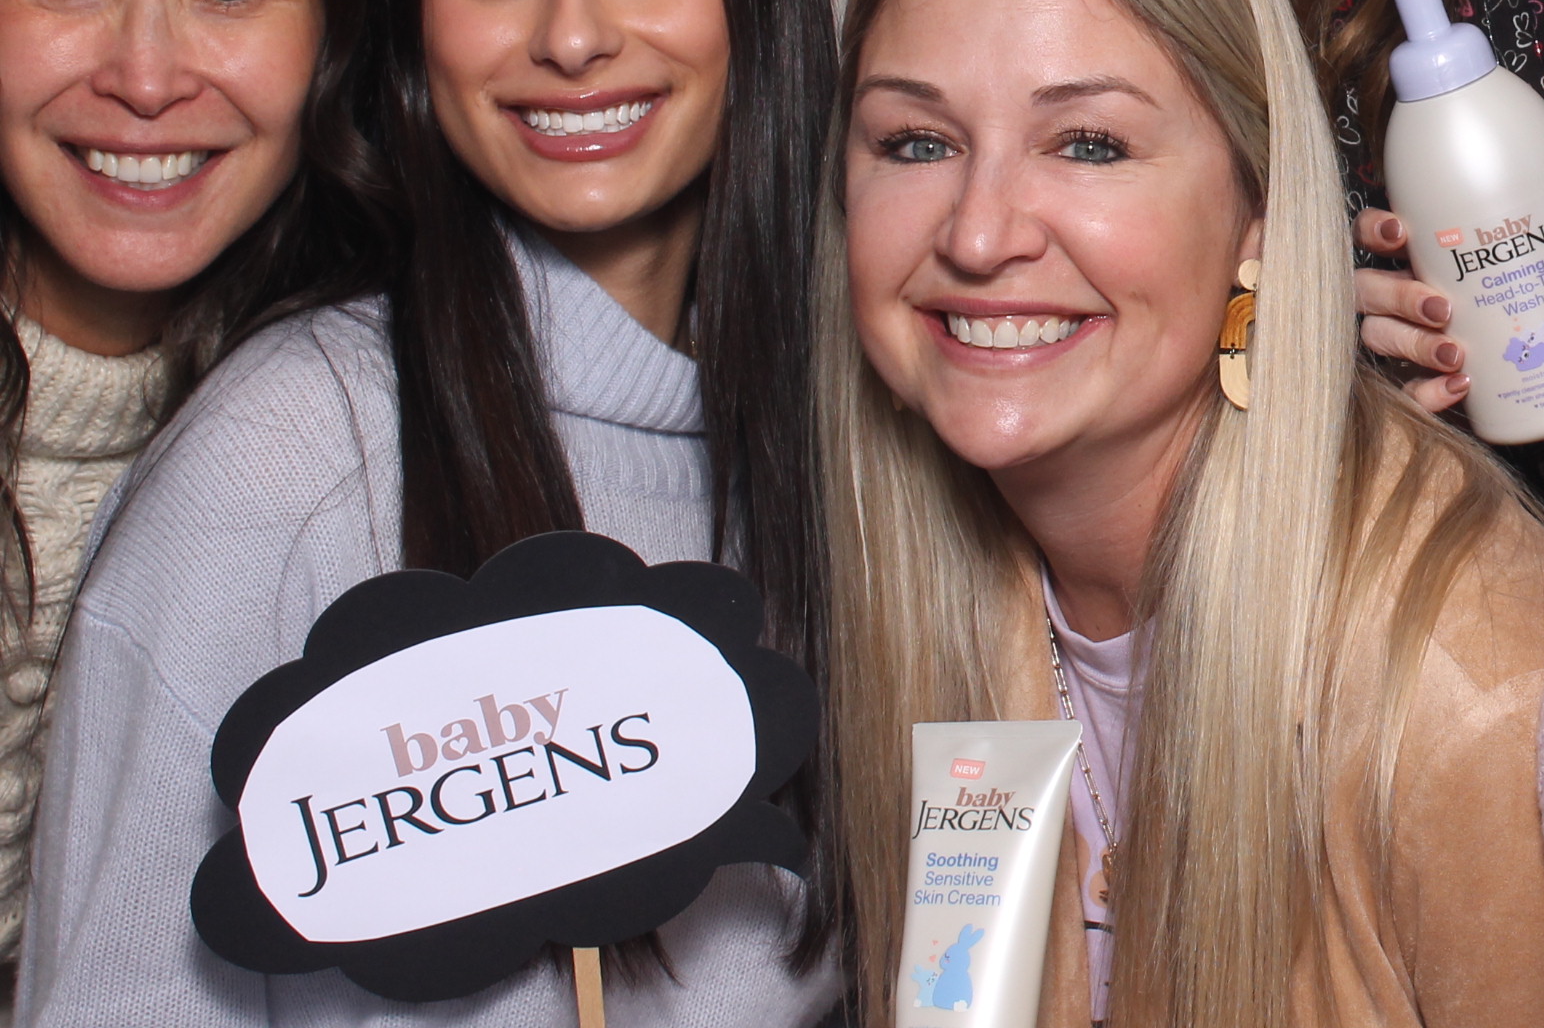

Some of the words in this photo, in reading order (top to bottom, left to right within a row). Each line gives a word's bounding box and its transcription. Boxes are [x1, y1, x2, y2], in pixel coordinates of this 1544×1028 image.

[1440, 233, 1460, 244] NEW
[1474, 214, 1532, 247] baby
[380, 688, 569, 778] baby
[954, 764, 981, 776] NEW
[290, 712, 659, 898] JERGENS
[955, 786, 1017, 811] baby
[912, 800, 1035, 840] JERGENS
[926, 852, 999, 872] Soothing
[924, 870, 994, 887] Sensitive
[913, 889, 944, 906] Skin
[947, 889, 1001, 907] Cream
